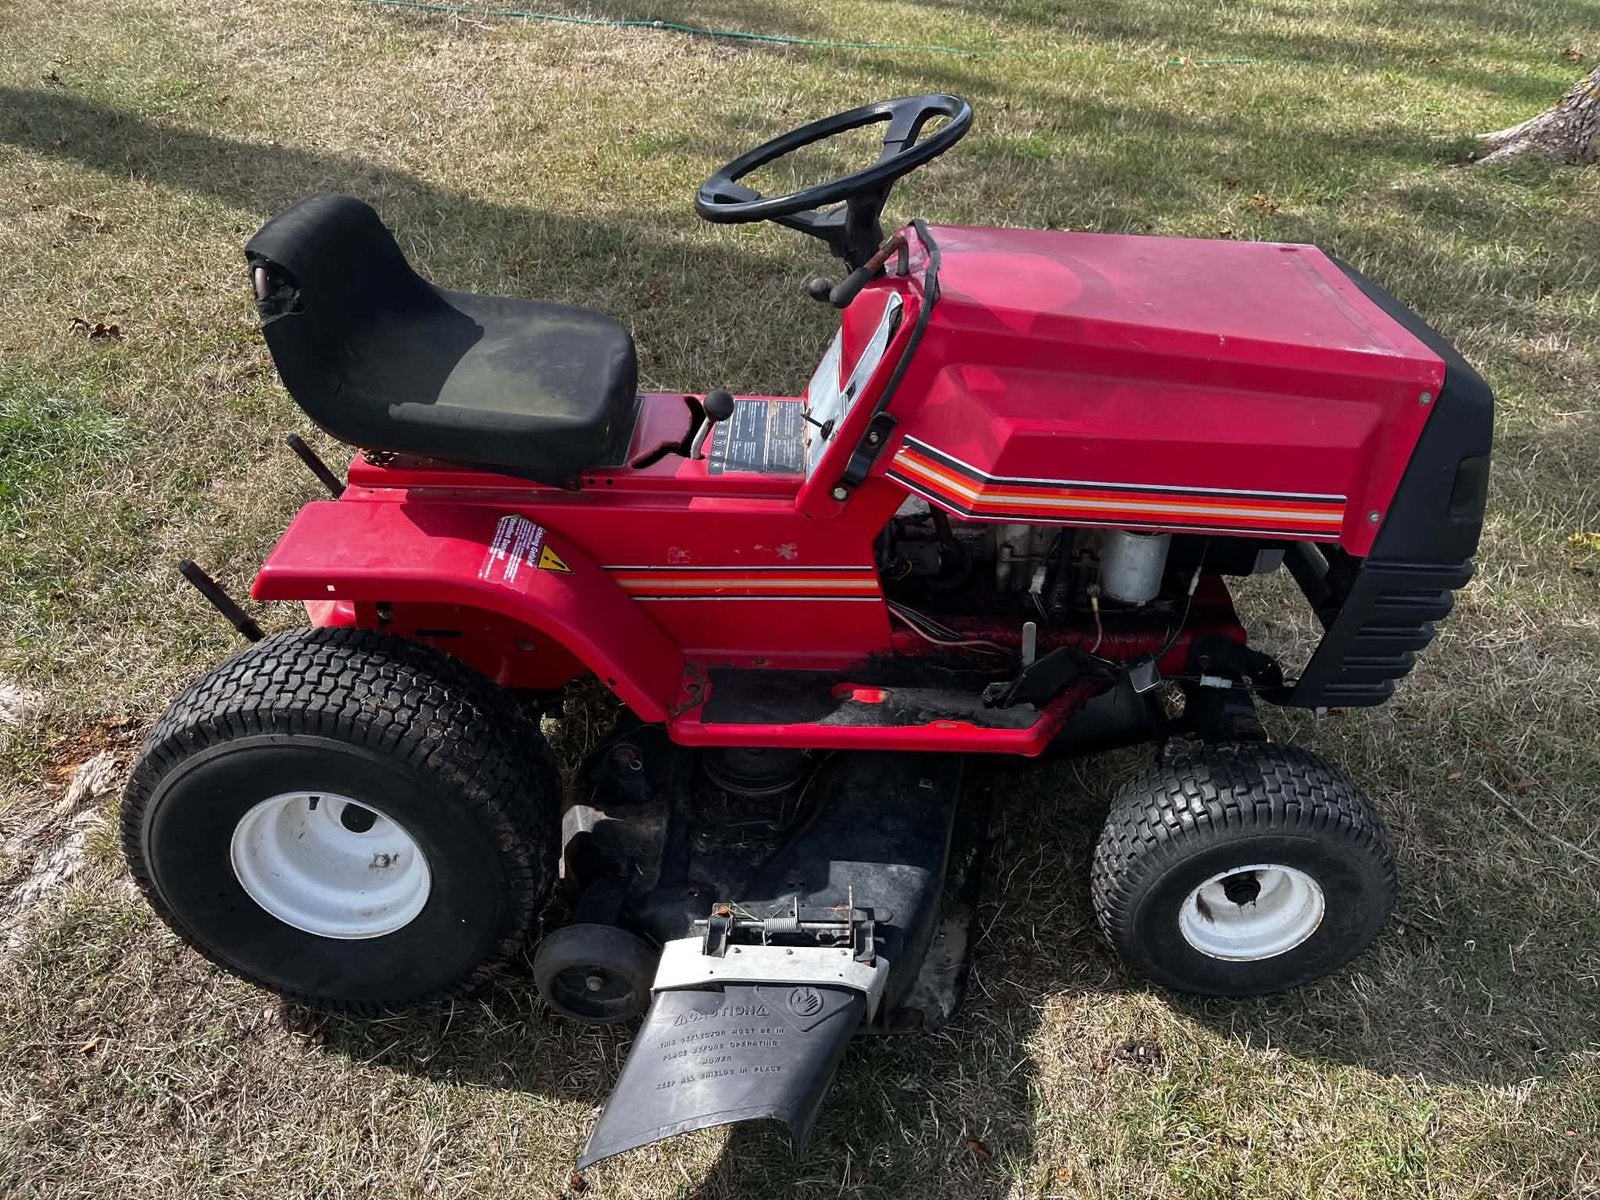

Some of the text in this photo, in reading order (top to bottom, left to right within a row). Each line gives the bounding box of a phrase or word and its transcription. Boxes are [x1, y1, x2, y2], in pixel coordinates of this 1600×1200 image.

[680, 1030, 726, 1044] DEFLECTOR
[731, 1027, 755, 1035] MUST
[662, 1039, 778, 1061] PLACE BEFORE OPERATING
[702, 1056, 732, 1065] MOWER
[656, 1065, 782, 1090] KEEP ALL SHIELDS IN PLACE
